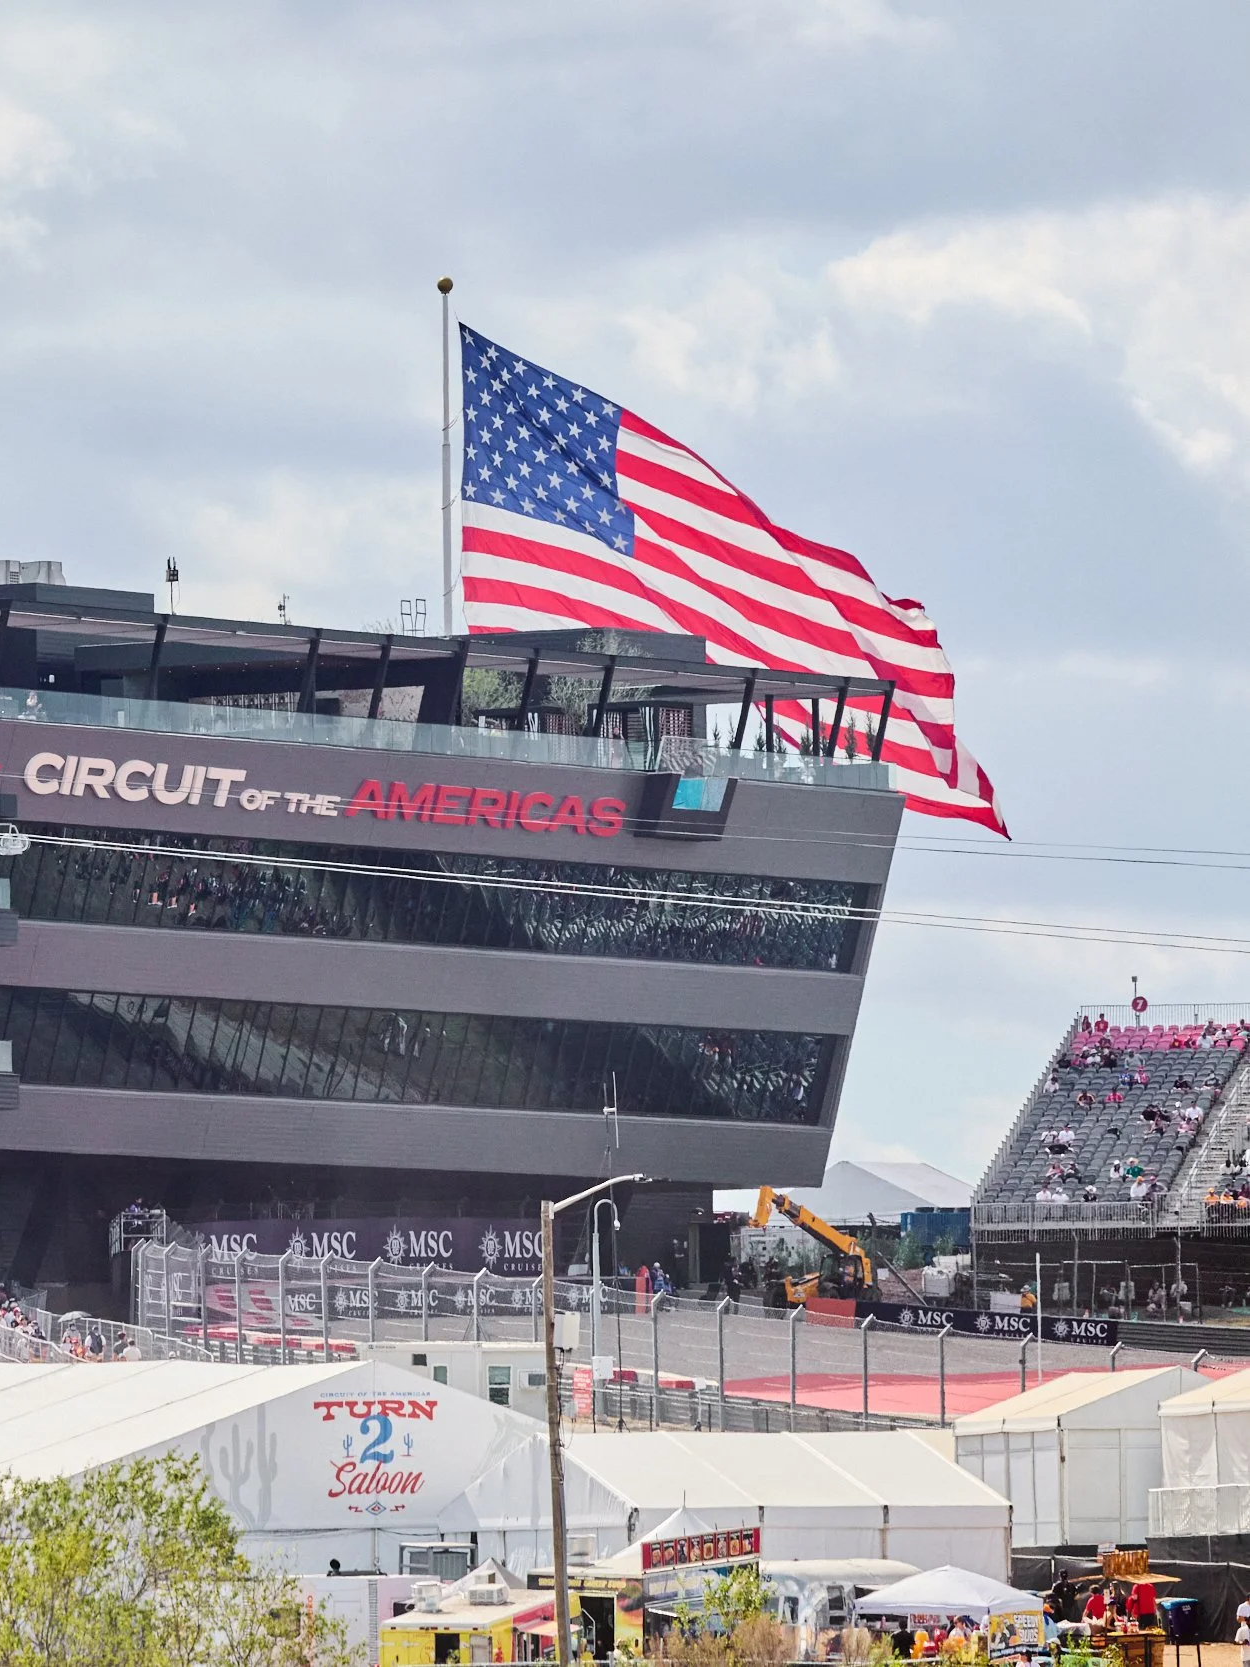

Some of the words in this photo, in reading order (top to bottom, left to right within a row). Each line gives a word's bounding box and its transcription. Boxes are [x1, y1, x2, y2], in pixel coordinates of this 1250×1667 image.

[24, 752, 247, 807] CIRCUIT
[239, 788, 281, 811] OF
[284, 792, 341, 816] THE
[344, 779, 626, 838] AMERICAS
[210, 1233, 257, 1262] MSC
[311, 1231, 356, 1259] MSC
[408, 1230, 453, 1258] MSC
[211, 1266, 259, 1276] CRUSES
[504, 1263, 542, 1272] CRUISE
[411, 1289, 439, 1307] MC
[582, 1286, 609, 1303] MC
[917, 1309, 954, 1327] MSC
[994, 1315, 1031, 1332] MSC
[1071, 1321, 1108, 1338] MSC
[313, 1400, 438, 1421] TURN
[359, 1414, 394, 1464] 2
[328, 1460, 425, 1498] Saloon
